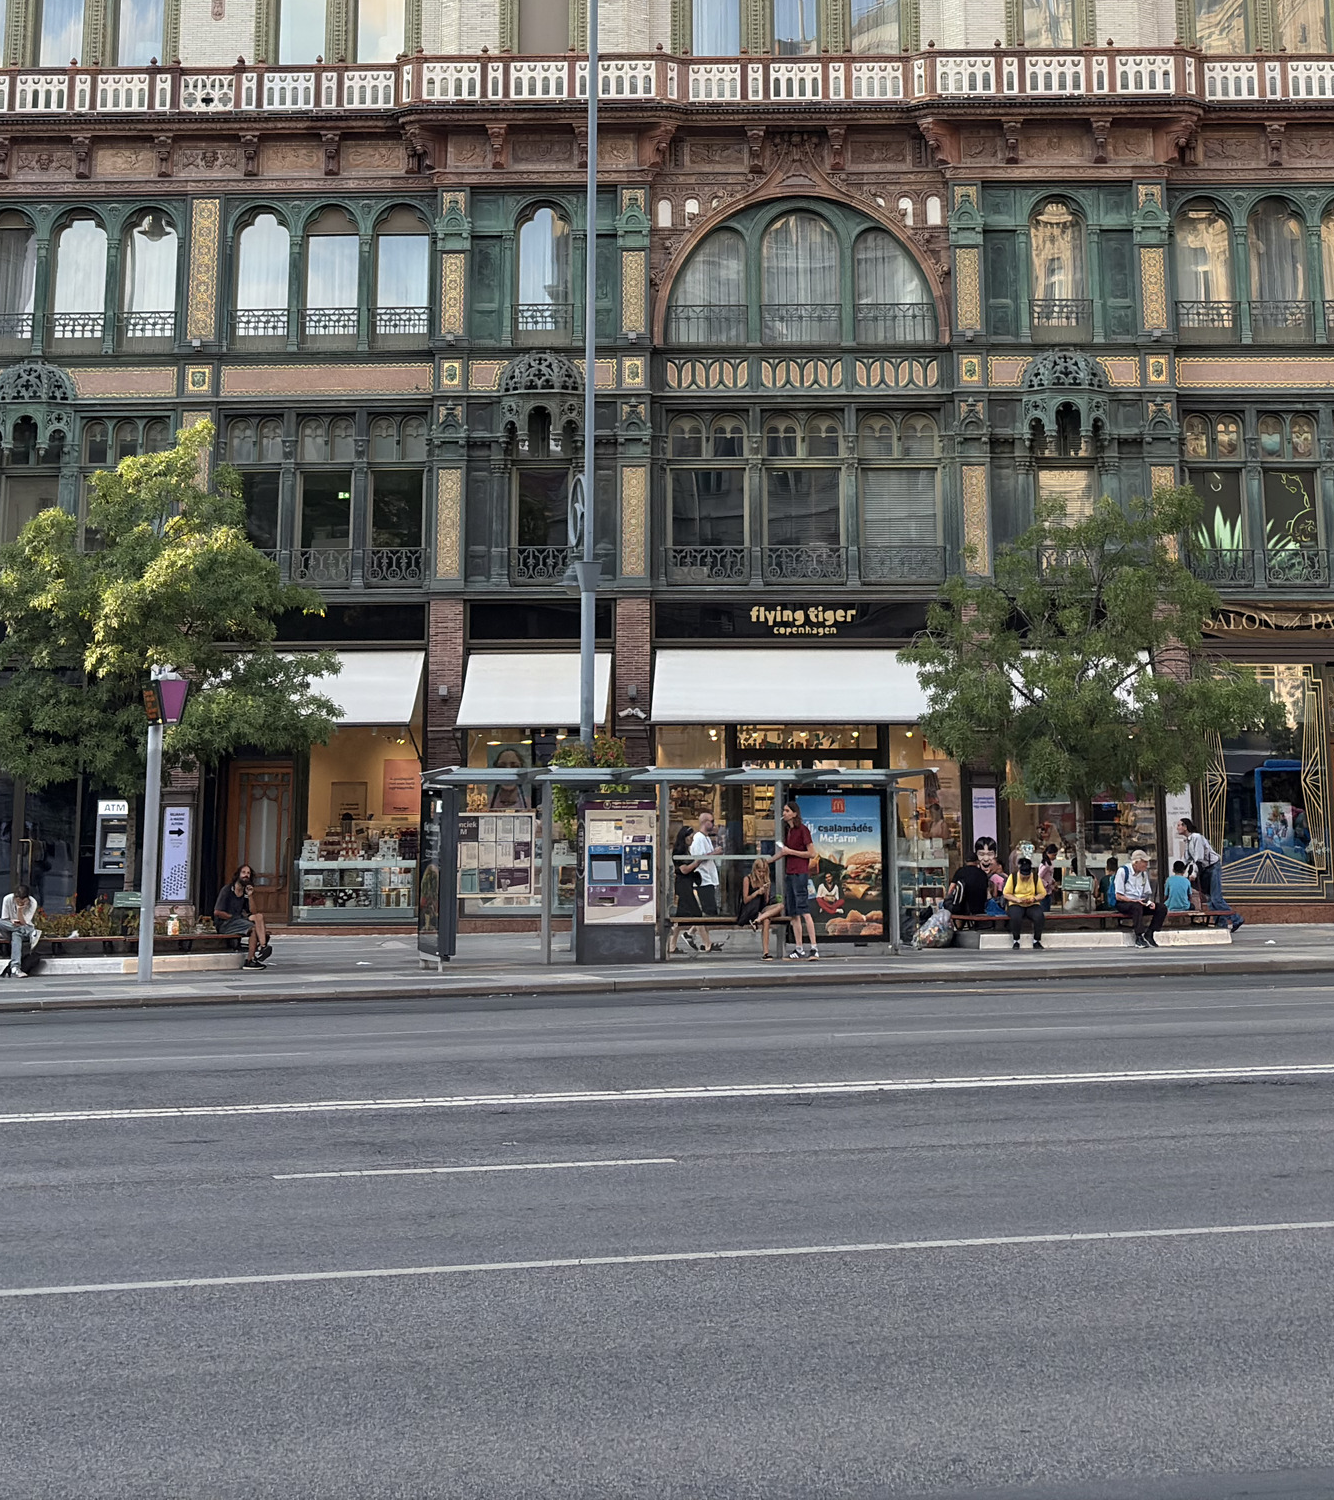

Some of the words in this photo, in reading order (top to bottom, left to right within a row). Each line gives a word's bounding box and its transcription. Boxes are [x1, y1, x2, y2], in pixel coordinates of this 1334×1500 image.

[750, 605, 805, 626] flying
[807, 605, 856, 626] tiger
[1201, 613, 1276, 630] SALON
[773, 625, 837, 636] copenhagen
[818, 822, 873, 833] csalamádés
